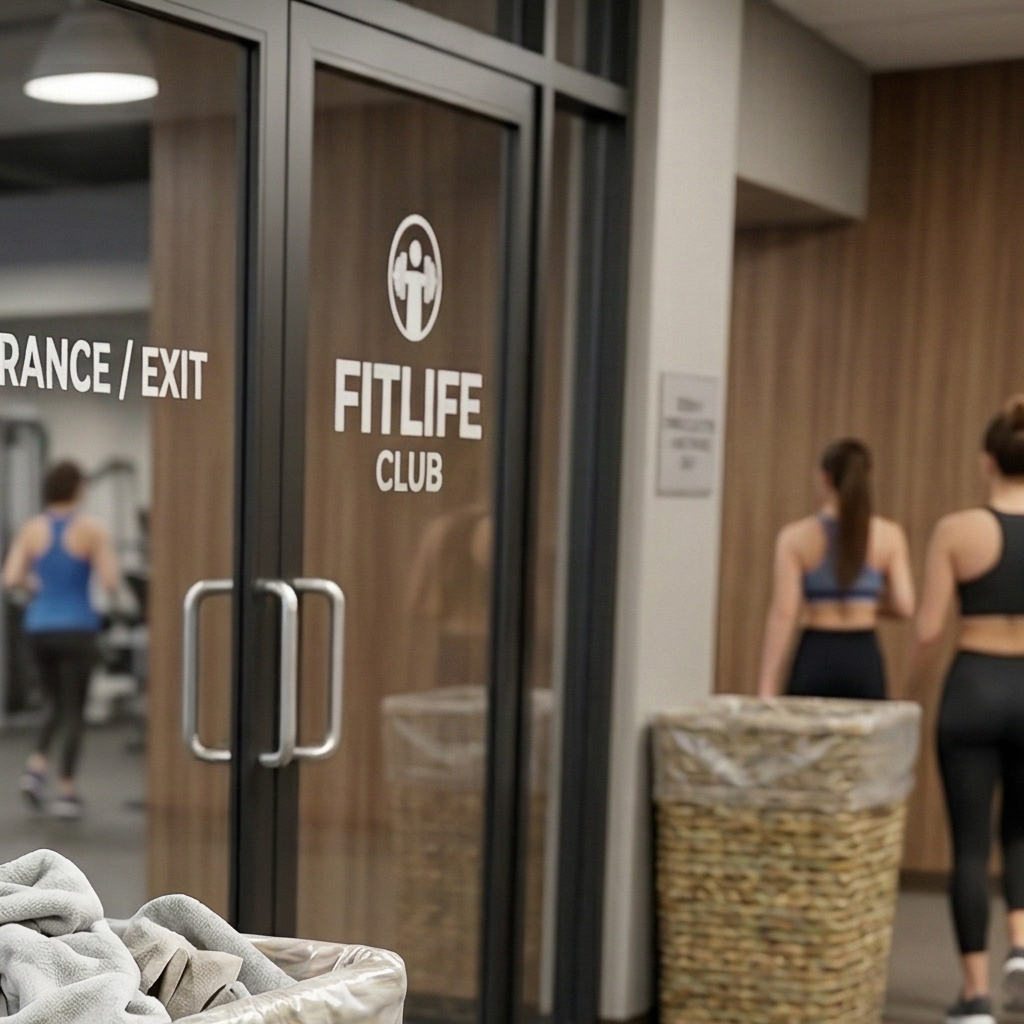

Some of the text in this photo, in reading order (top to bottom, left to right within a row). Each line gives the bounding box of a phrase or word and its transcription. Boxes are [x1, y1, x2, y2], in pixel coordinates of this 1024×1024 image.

[119, 339, 133, 401] /
[142, 346, 207, 400] EXIT
[334, 358, 483, 440] FITLIFE
[376, 449, 443, 493] CLUB
